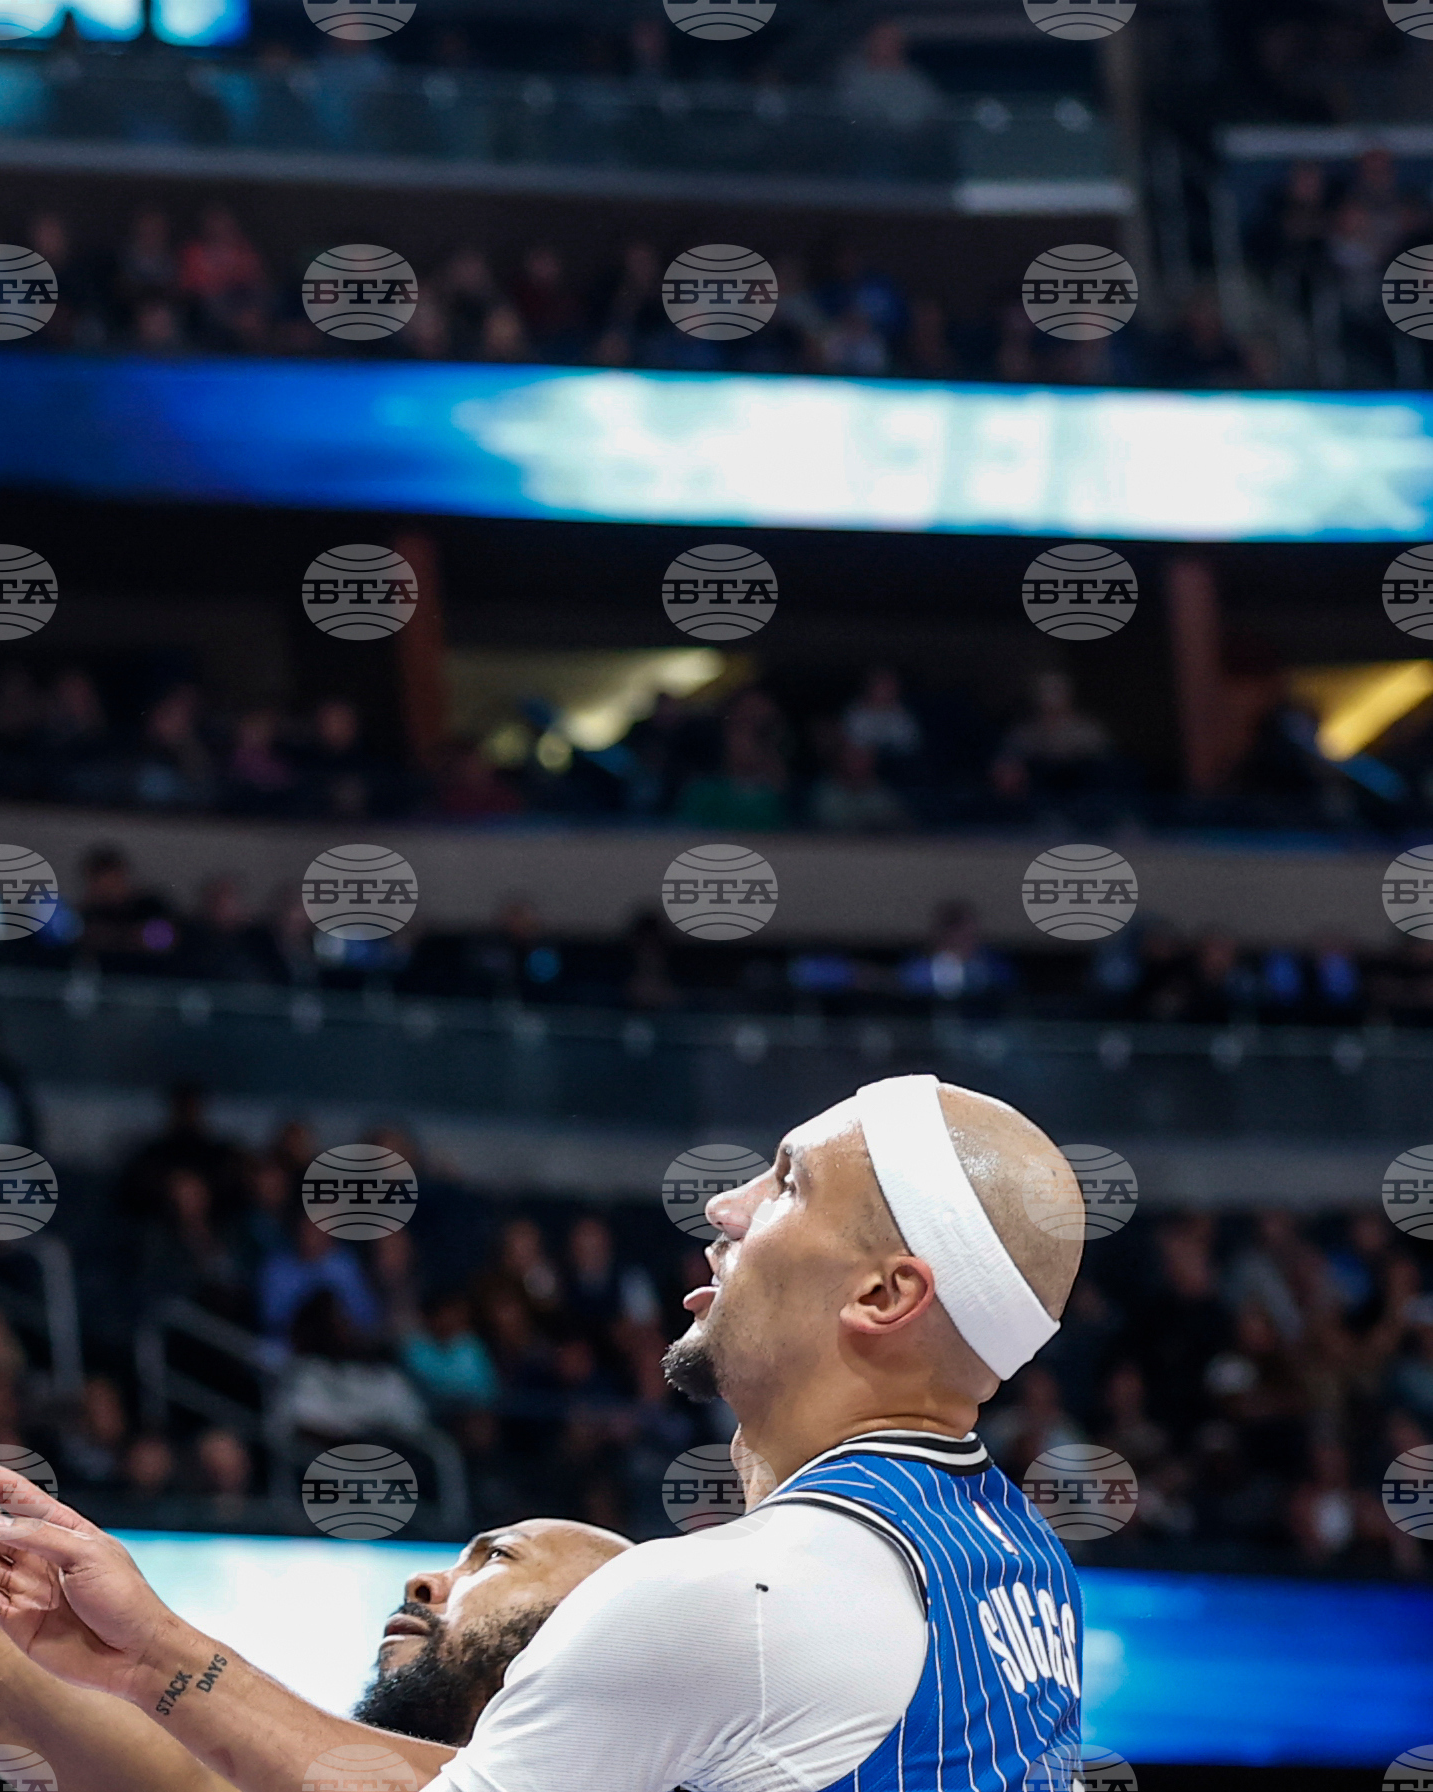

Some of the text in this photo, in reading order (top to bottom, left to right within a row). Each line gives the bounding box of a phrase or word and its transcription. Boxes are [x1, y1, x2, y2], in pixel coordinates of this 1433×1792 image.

[978, 1581, 1081, 1699] SUGGS
[156, 1670, 193, 1716] STACK
[196, 1653, 228, 1693] DAYS
